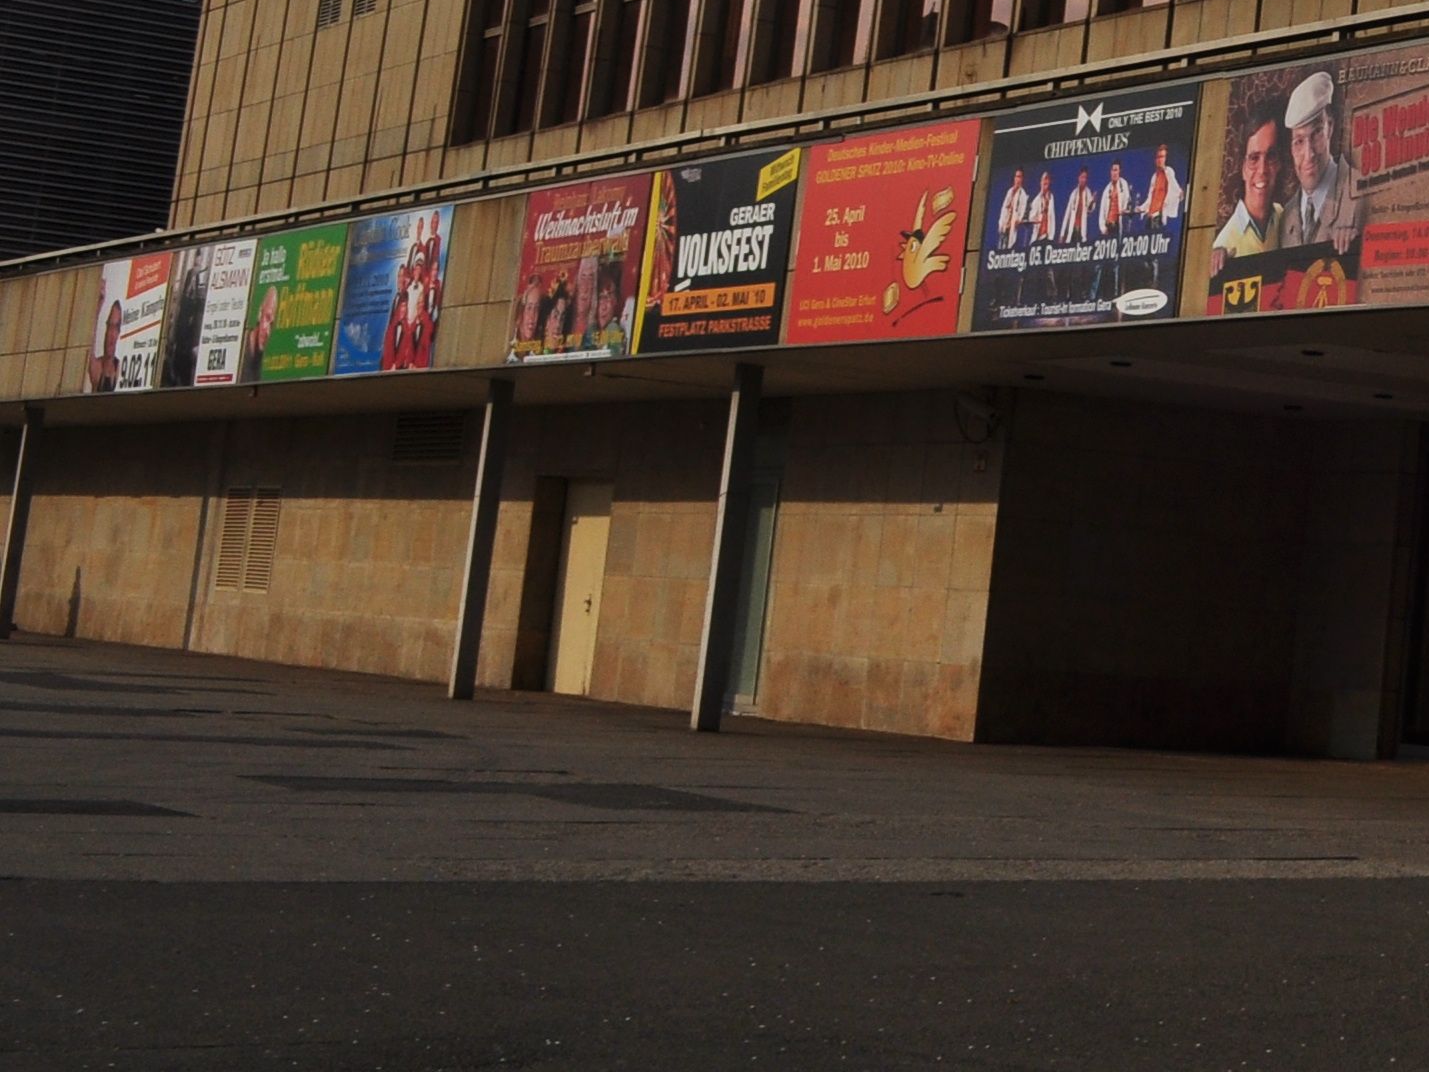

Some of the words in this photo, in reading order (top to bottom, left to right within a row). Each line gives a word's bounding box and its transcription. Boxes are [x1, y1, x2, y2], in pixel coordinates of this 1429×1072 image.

[1108, 115, 1129, 129] ONLY
[1130, 112, 1144, 125] THE
[1145, 109, 1165, 123] BEST
[1166, 106, 1183, 119] 2010
[1044, 132, 1130, 160] CHIPPENDALES
[730, 202, 776, 226] GERAER
[824, 208, 840, 227] 25.
[842, 204, 866, 227] April
[677, 224, 774, 278] VOLKSFEST
[834, 230, 850, 248] bis
[811, 257, 820, 274] 1.
[824, 253, 842, 271] Mai
[843, 250, 870, 270] 2010
[987, 249, 1027, 272] Sonntag,
[1029, 250, 1042, 266] 05.
[1044, 243, 1092, 265] Dezember
[1093, 238, 1119, 262] 2010,
[1120, 235, 1148, 258] 20:00
[1150, 233, 1171, 255] Uhr
[683, 294, 708, 309] APRIL
[732, 290, 749, 306] MAI
[658, 319, 707, 338] FESTPLATZ
[707, 314, 772, 335] PARKSTRASSE
